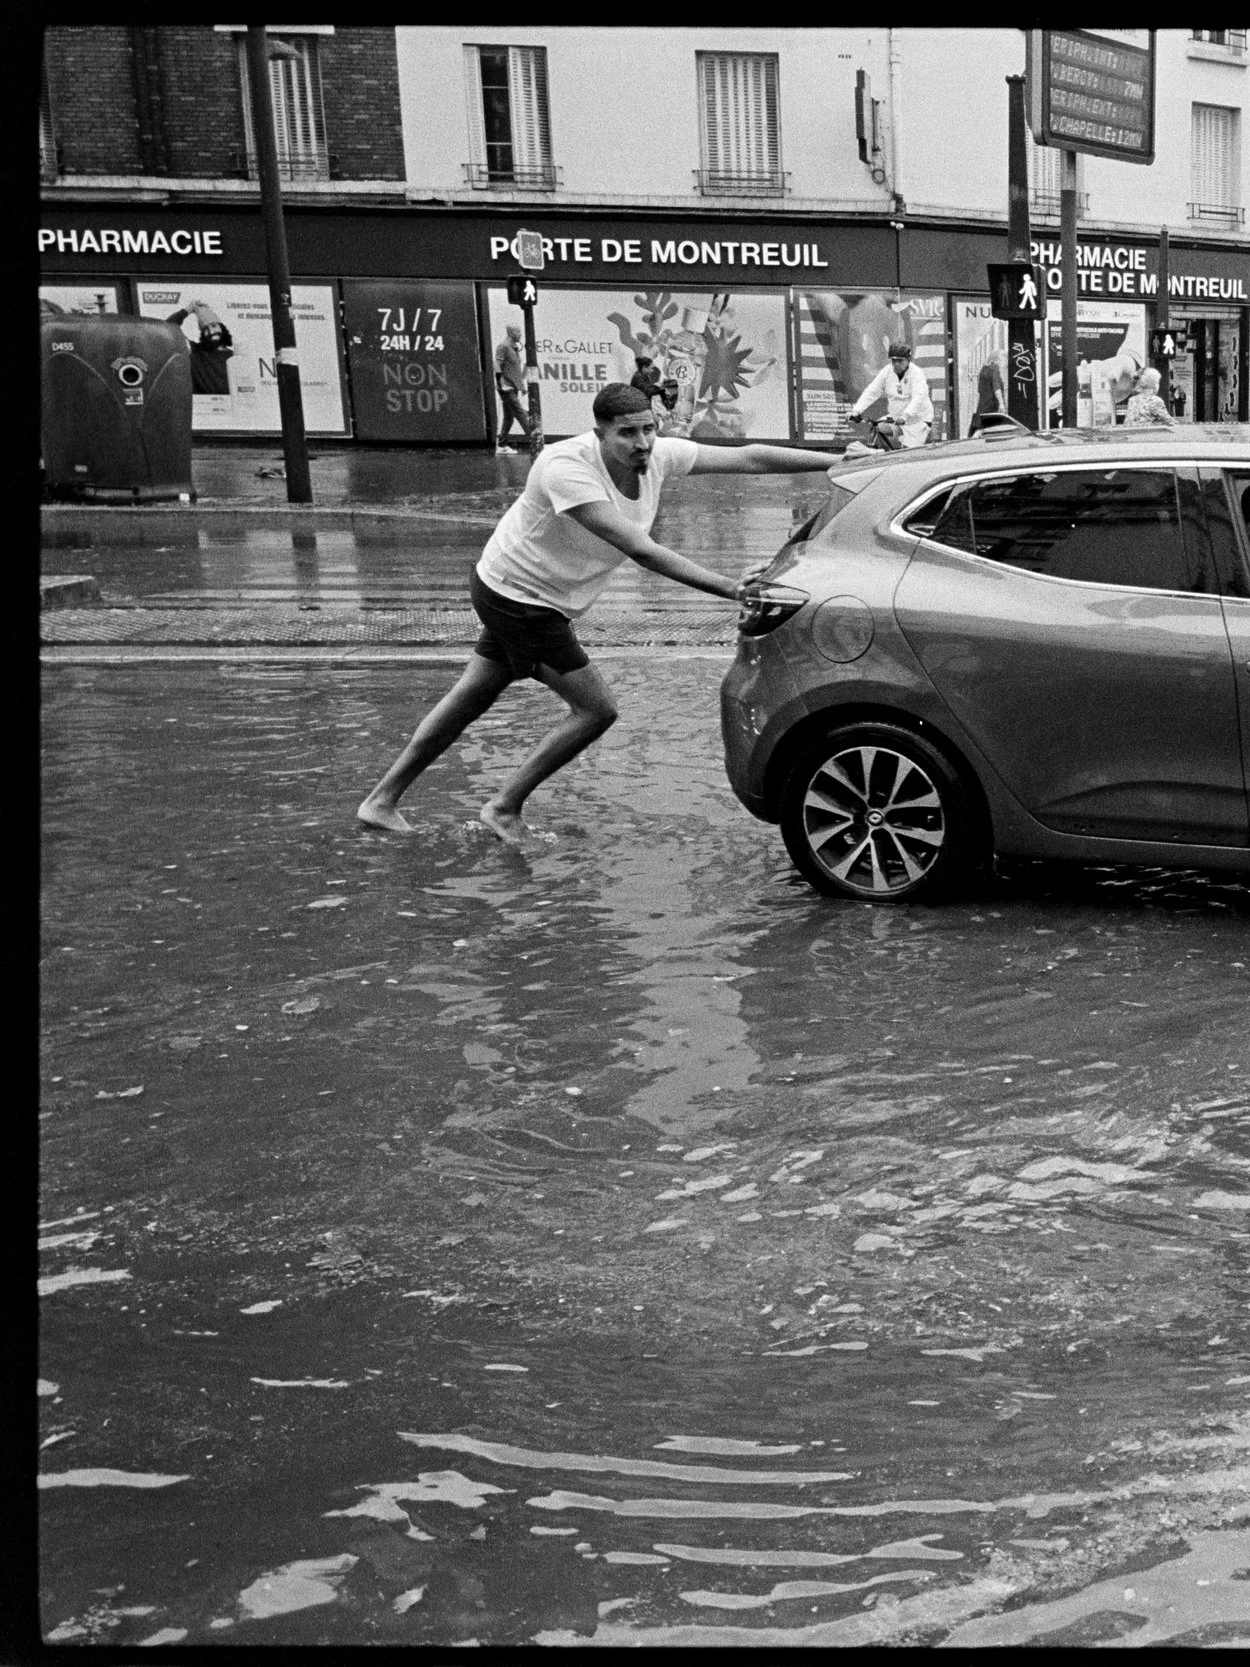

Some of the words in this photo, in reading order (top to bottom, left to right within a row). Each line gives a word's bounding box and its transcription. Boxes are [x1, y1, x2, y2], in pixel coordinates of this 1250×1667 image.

[38, 229, 223, 255] PHARMACIE
[601, 238, 642, 263] DE
[651, 240, 829, 267] MONTREUIL
[1047, 268, 1103, 292] OTE
[1108, 271, 1135, 293] DE
[1140, 273, 1248, 299] MNTREUIL
[909, 298, 942, 317] SVR
[377, 307, 406, 332] 7J
[412, 307, 421, 332] /
[427, 308, 442, 332] 7
[380, 335, 410, 351] 24H
[414, 335, 421, 351] /
[424, 335, 445, 351] 24
[554, 344, 564, 354] &
[564, 339, 613, 355] GALLET
[383, 363, 448, 386] NON
[538, 362, 608, 382] NILLE
[560, 381, 605, 394] SOLEI
[386, 389, 448, 412] STOP
